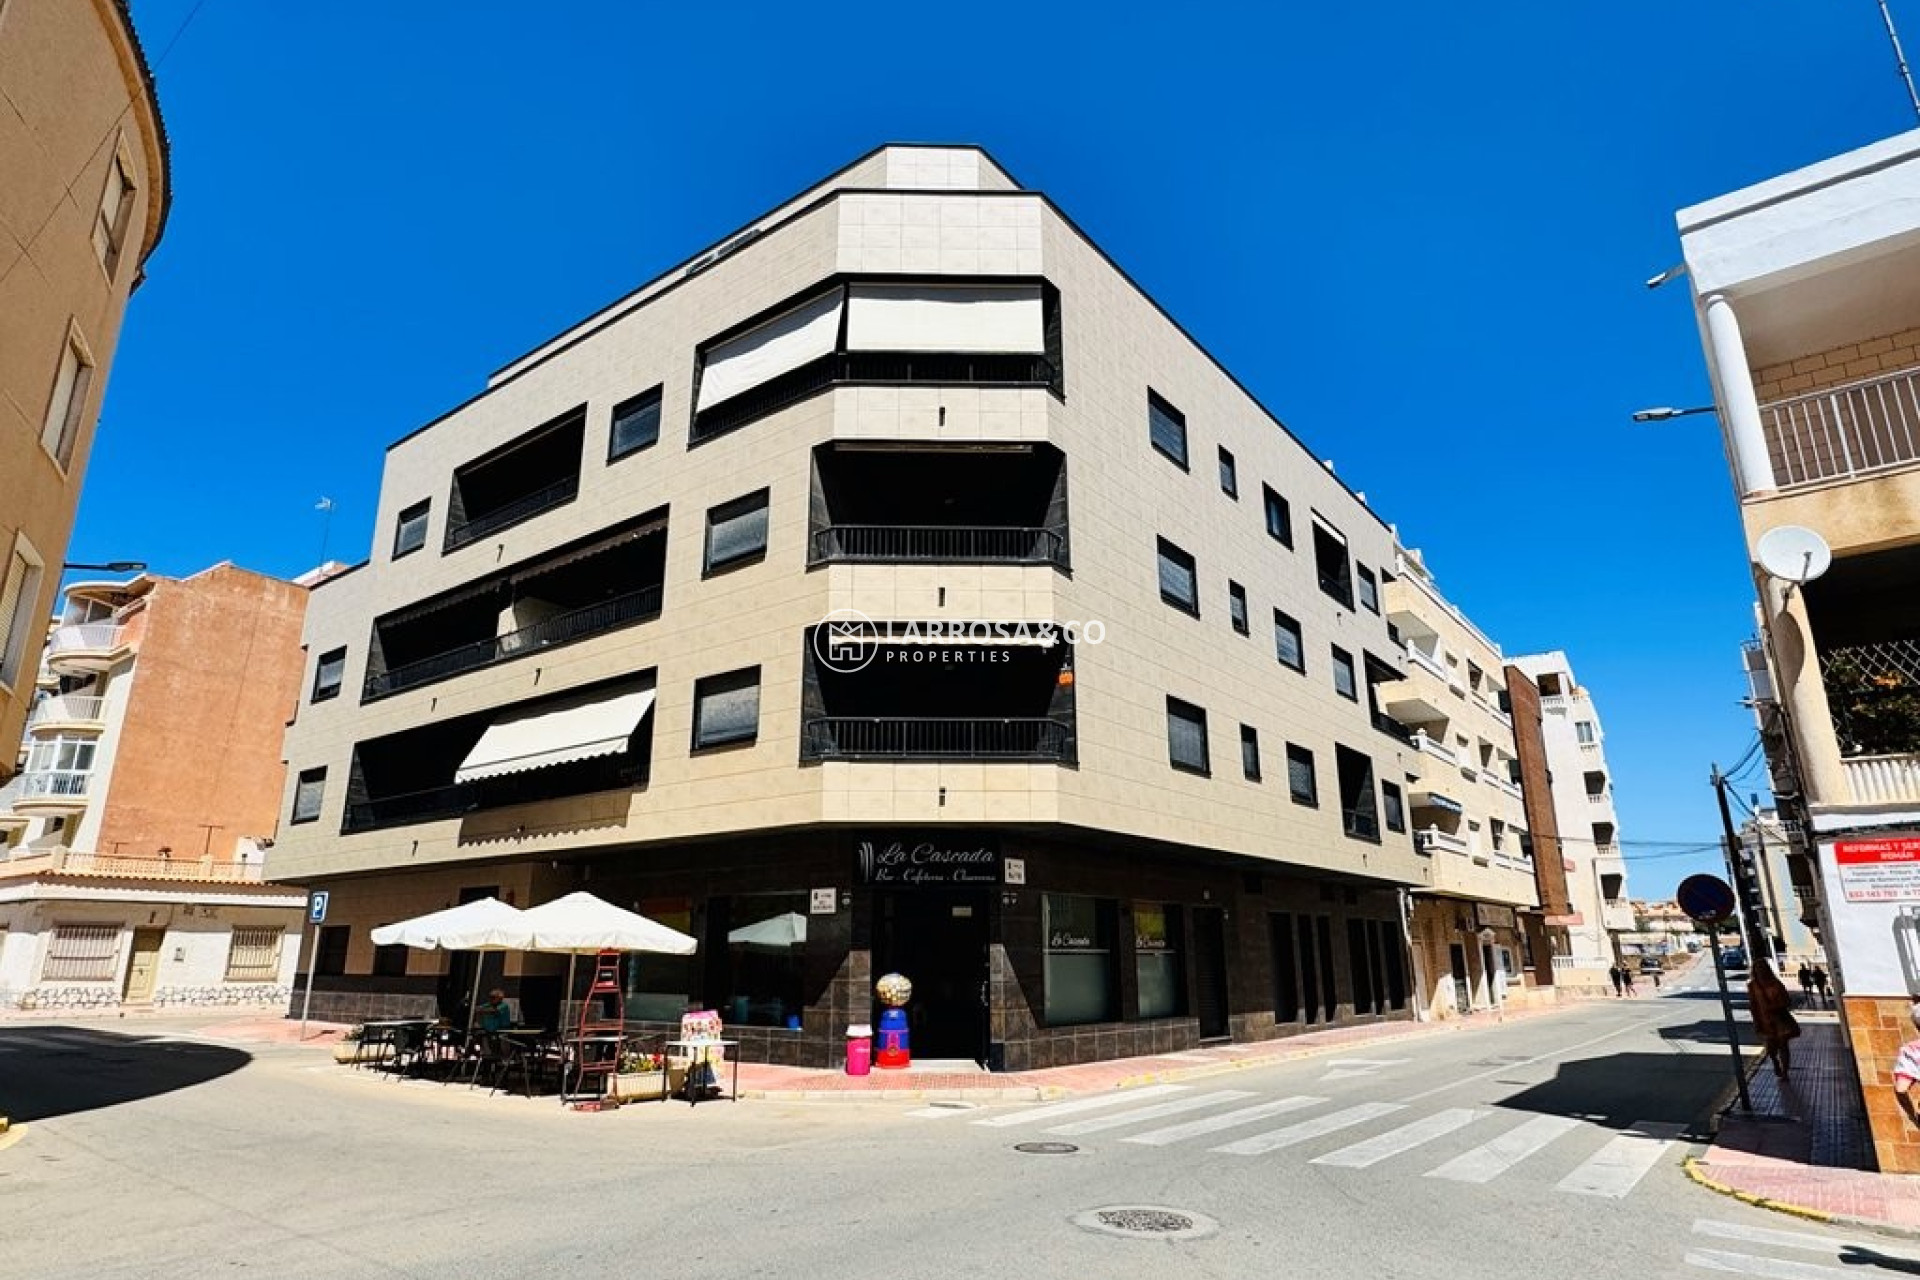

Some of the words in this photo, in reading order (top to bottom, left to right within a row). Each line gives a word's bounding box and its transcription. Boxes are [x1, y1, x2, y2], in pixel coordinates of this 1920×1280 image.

[877, 842, 907, 865] La
[910, 842, 994, 864] Cascada
[312, 896, 324, 918] P
